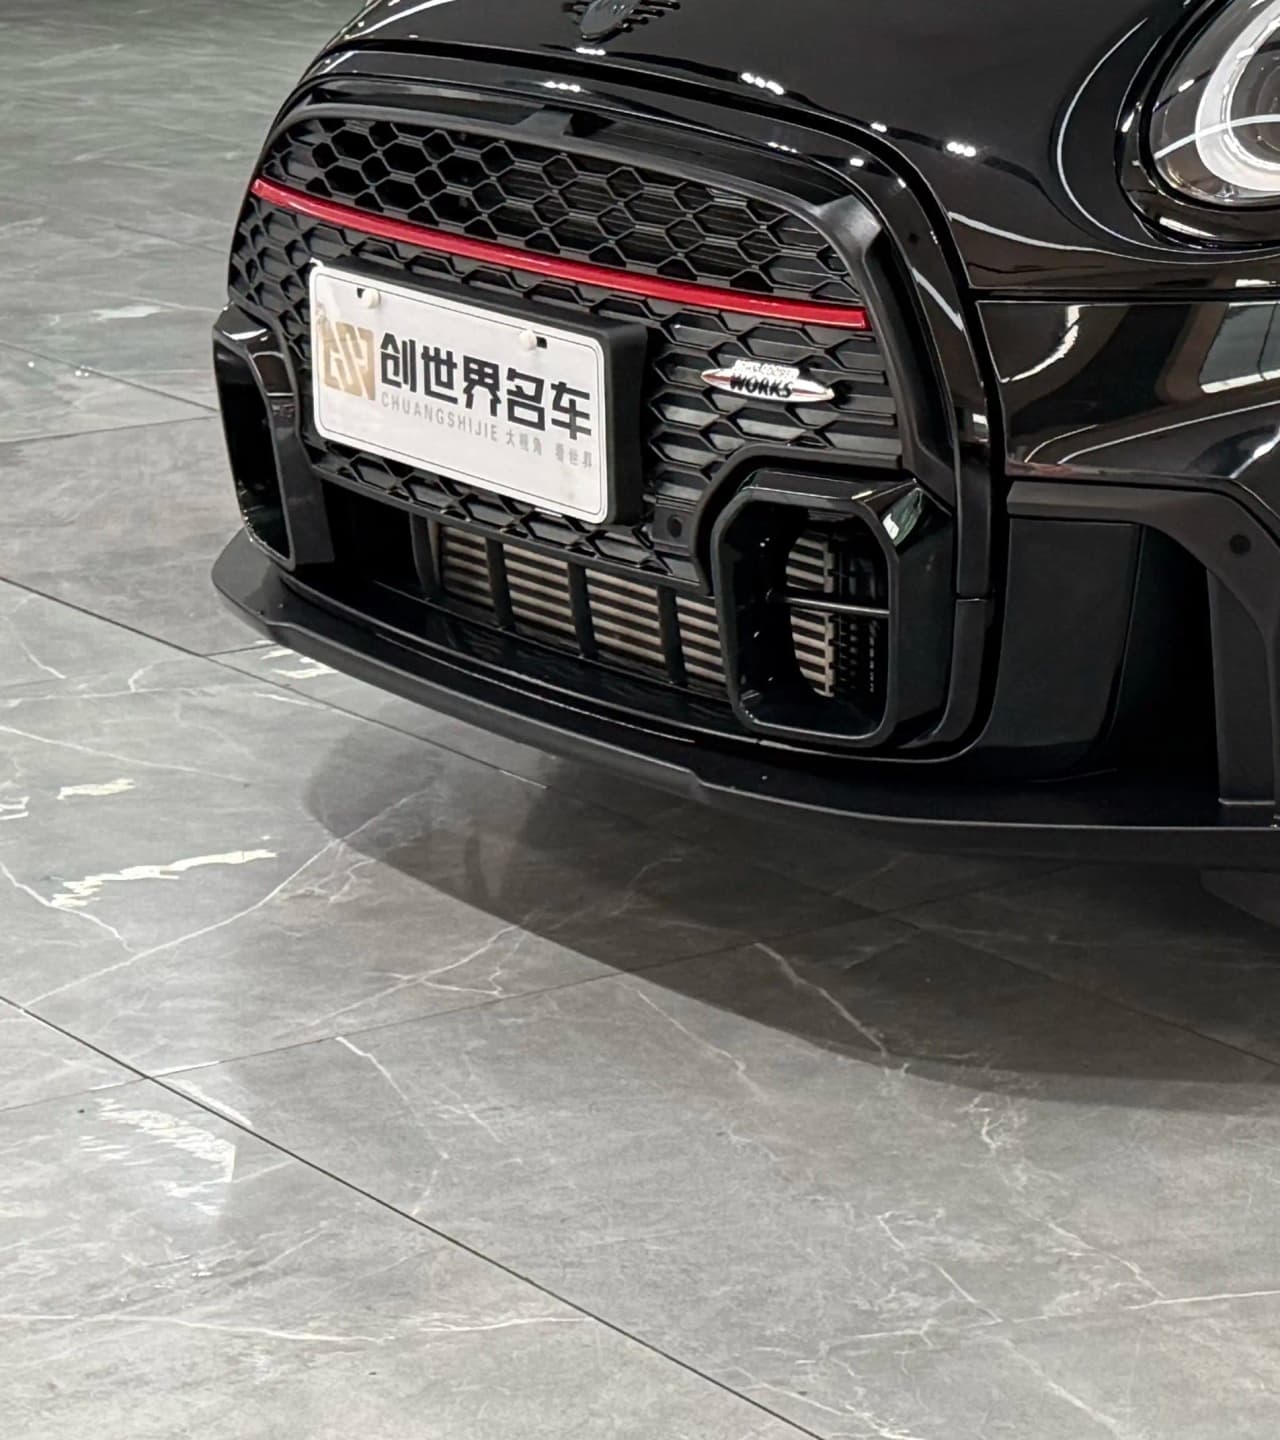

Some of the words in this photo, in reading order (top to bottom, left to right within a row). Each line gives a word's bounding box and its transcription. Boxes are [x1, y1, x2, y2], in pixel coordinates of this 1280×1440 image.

[380, 332, 592, 440] 创世界名车
[730, 372, 794, 399] WORKS
[381, 391, 498, 442] CHUANGSHIJIE
